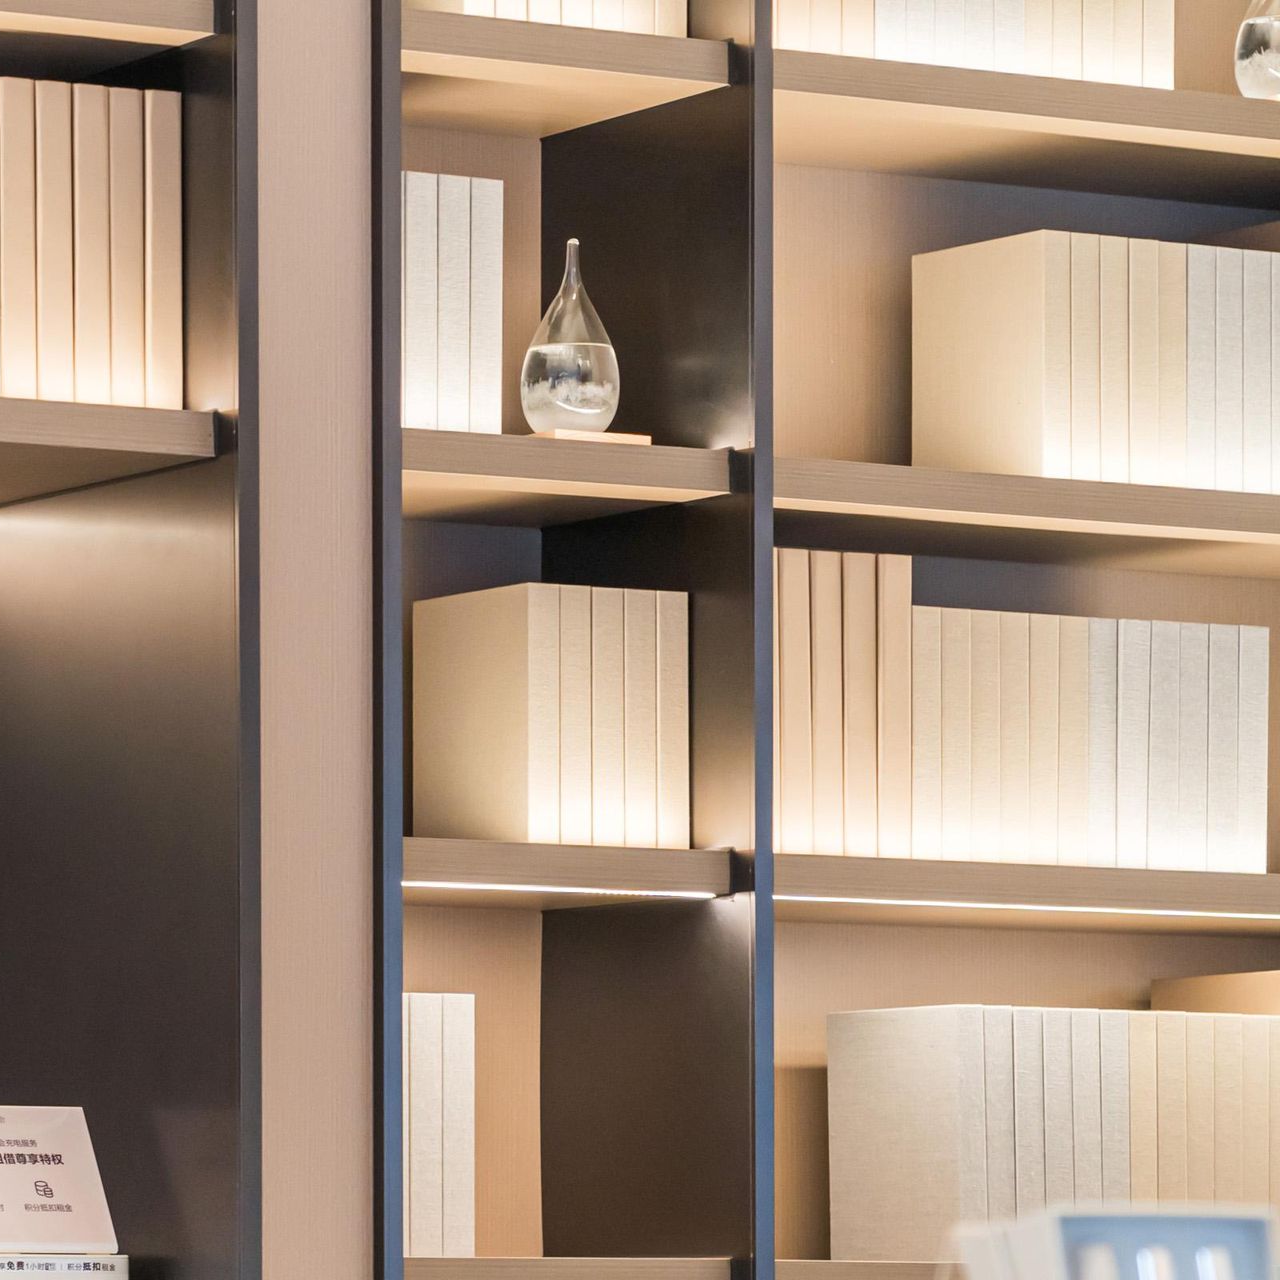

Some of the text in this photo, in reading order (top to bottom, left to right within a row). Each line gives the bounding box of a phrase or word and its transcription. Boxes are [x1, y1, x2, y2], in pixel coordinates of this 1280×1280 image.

[24, 1203, 73, 1213] 积分抵扣租金
